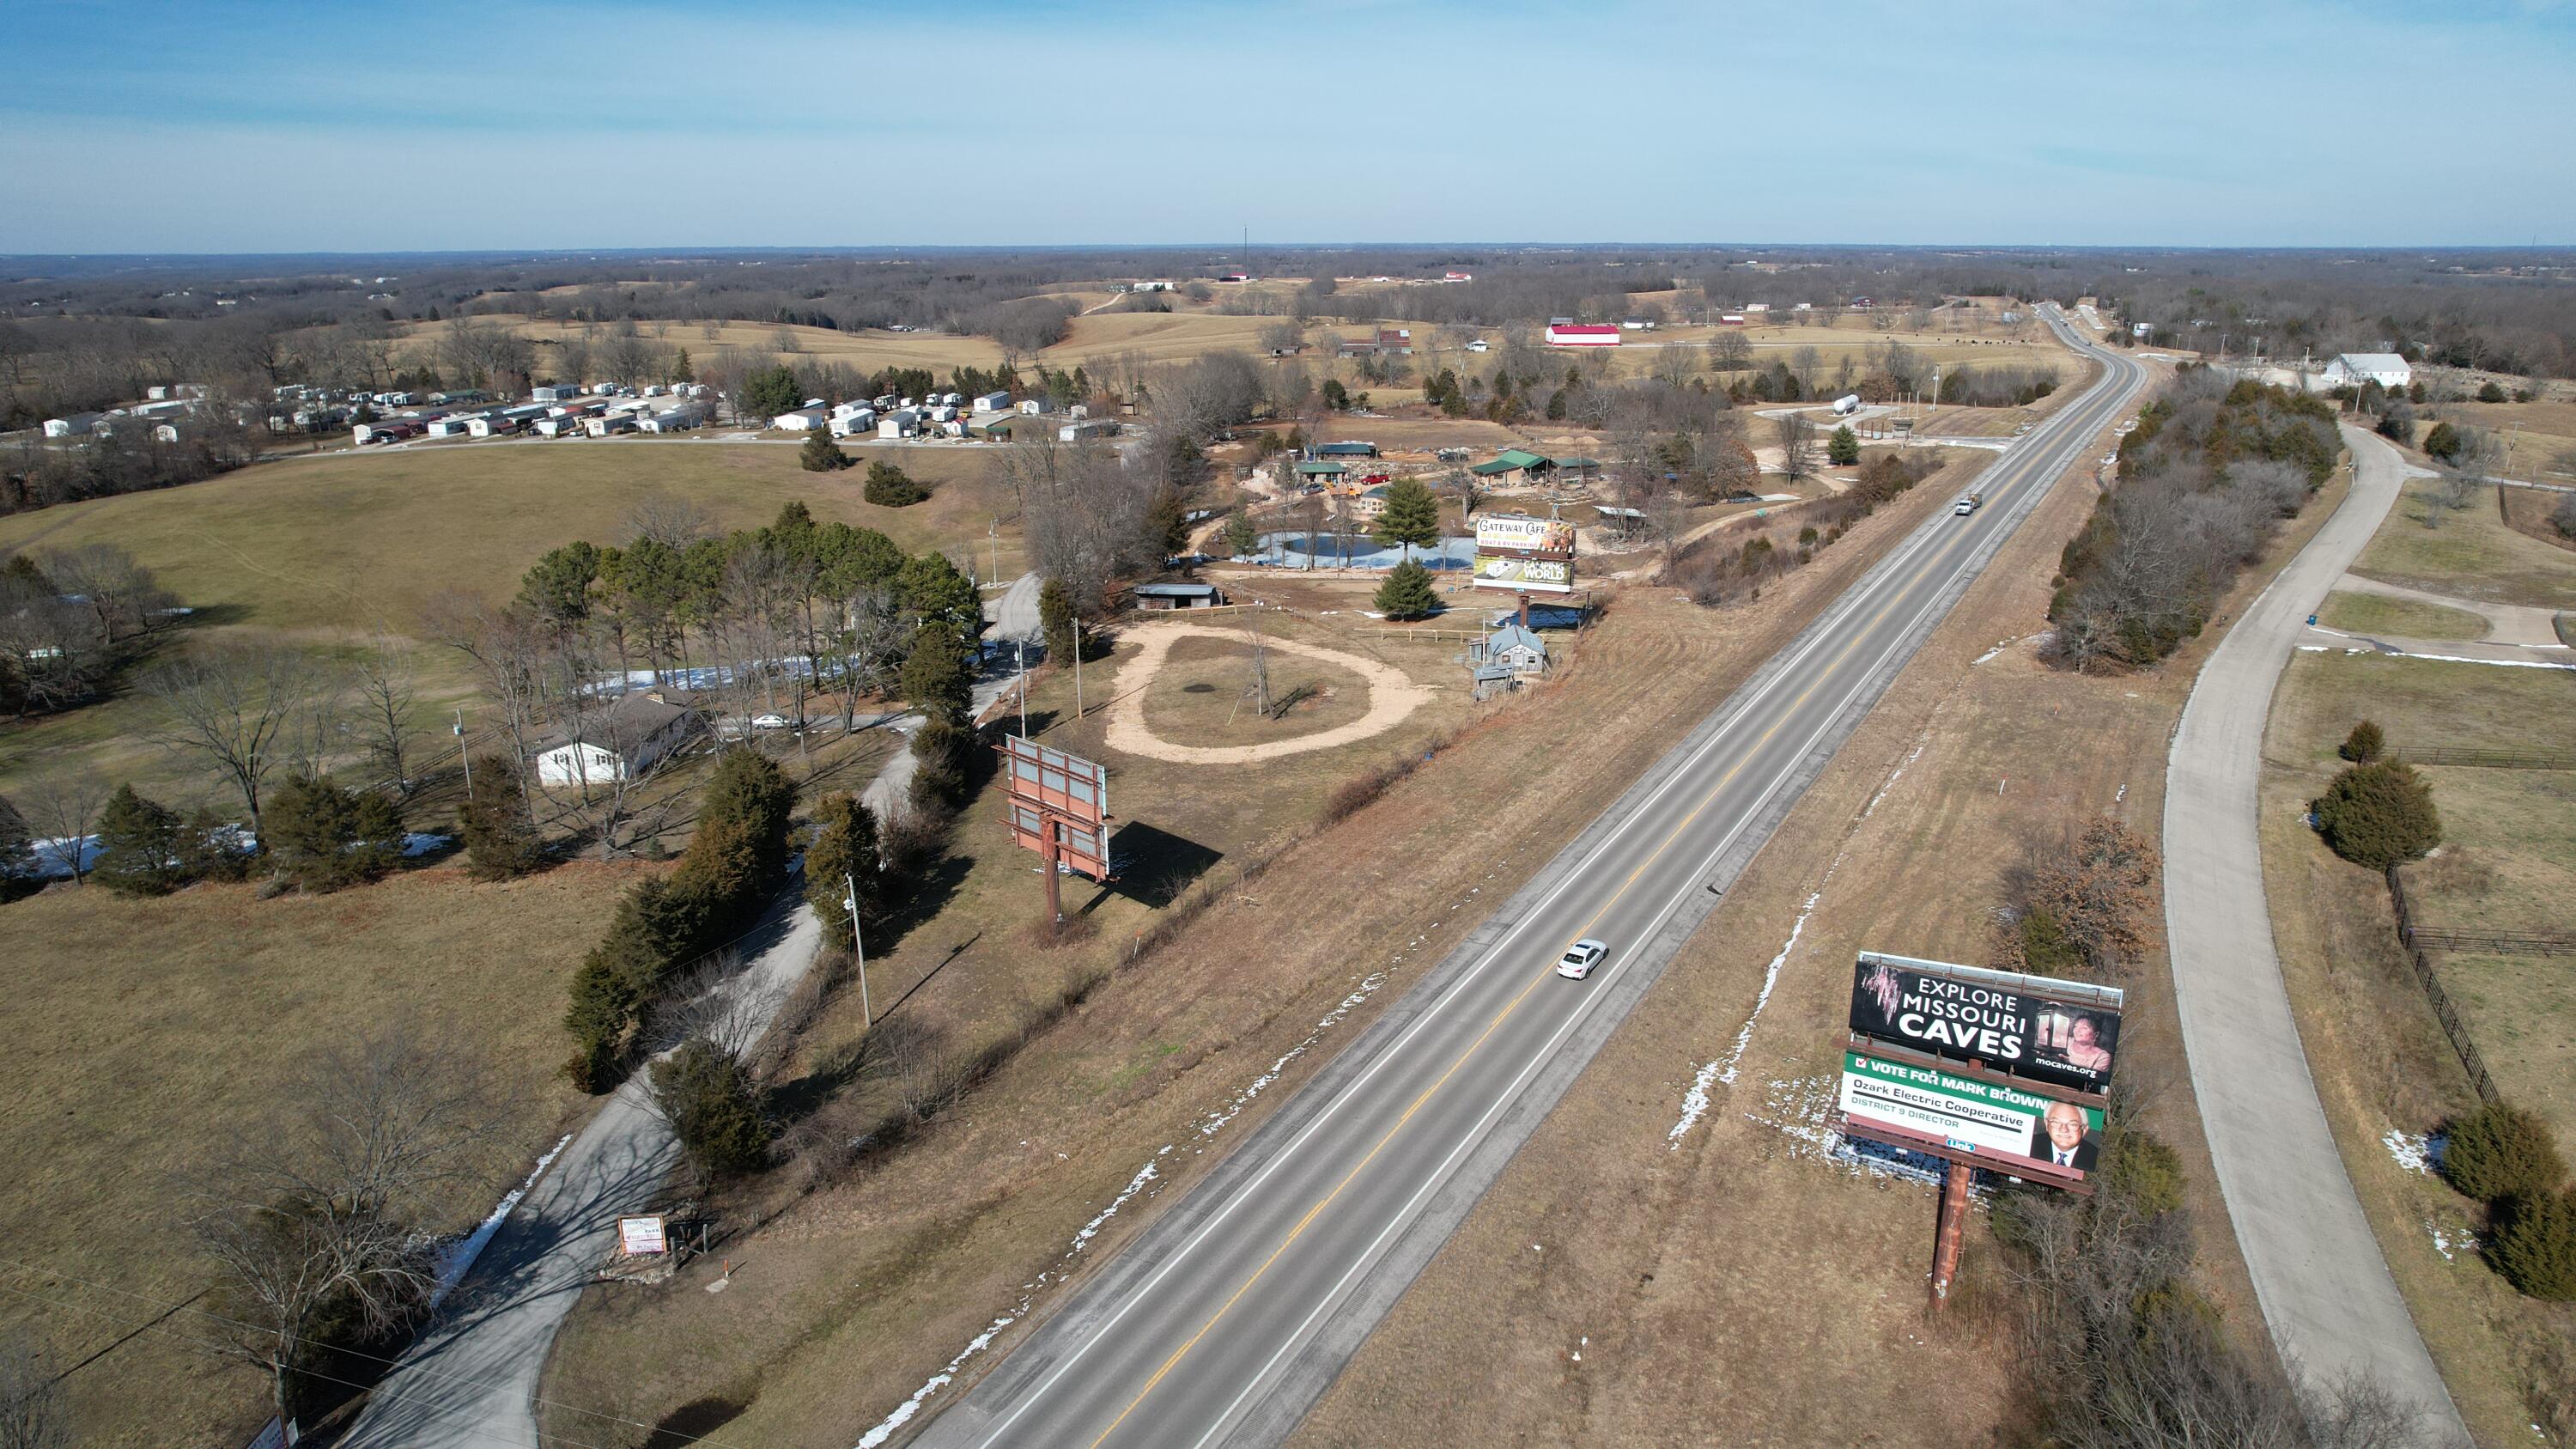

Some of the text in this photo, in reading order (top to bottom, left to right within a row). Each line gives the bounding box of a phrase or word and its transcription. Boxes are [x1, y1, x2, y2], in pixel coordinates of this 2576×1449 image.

[1479, 519, 1546, 536] GATEWAY CAFE
[1523, 560, 1564, 571] CAMPING
[1524, 568, 1564, 580] WORLD
[1918, 977, 2018, 1013] EXPLORE
[1902, 993, 2026, 1034] MISSOURI
[1899, 1013, 2022, 1059] CAVES
[2035, 1056, 2097, 1079] mocaves.org
[1853, 1079, 2024, 1127] Ozark Electric Cooperative
[1870, 1061, 2048, 1111] VOTE FOR MARK BROWN
[1851, 1096, 1897, 1113] DISTRICT
[1908, 1110, 1959, 1128] DIRECTOR
